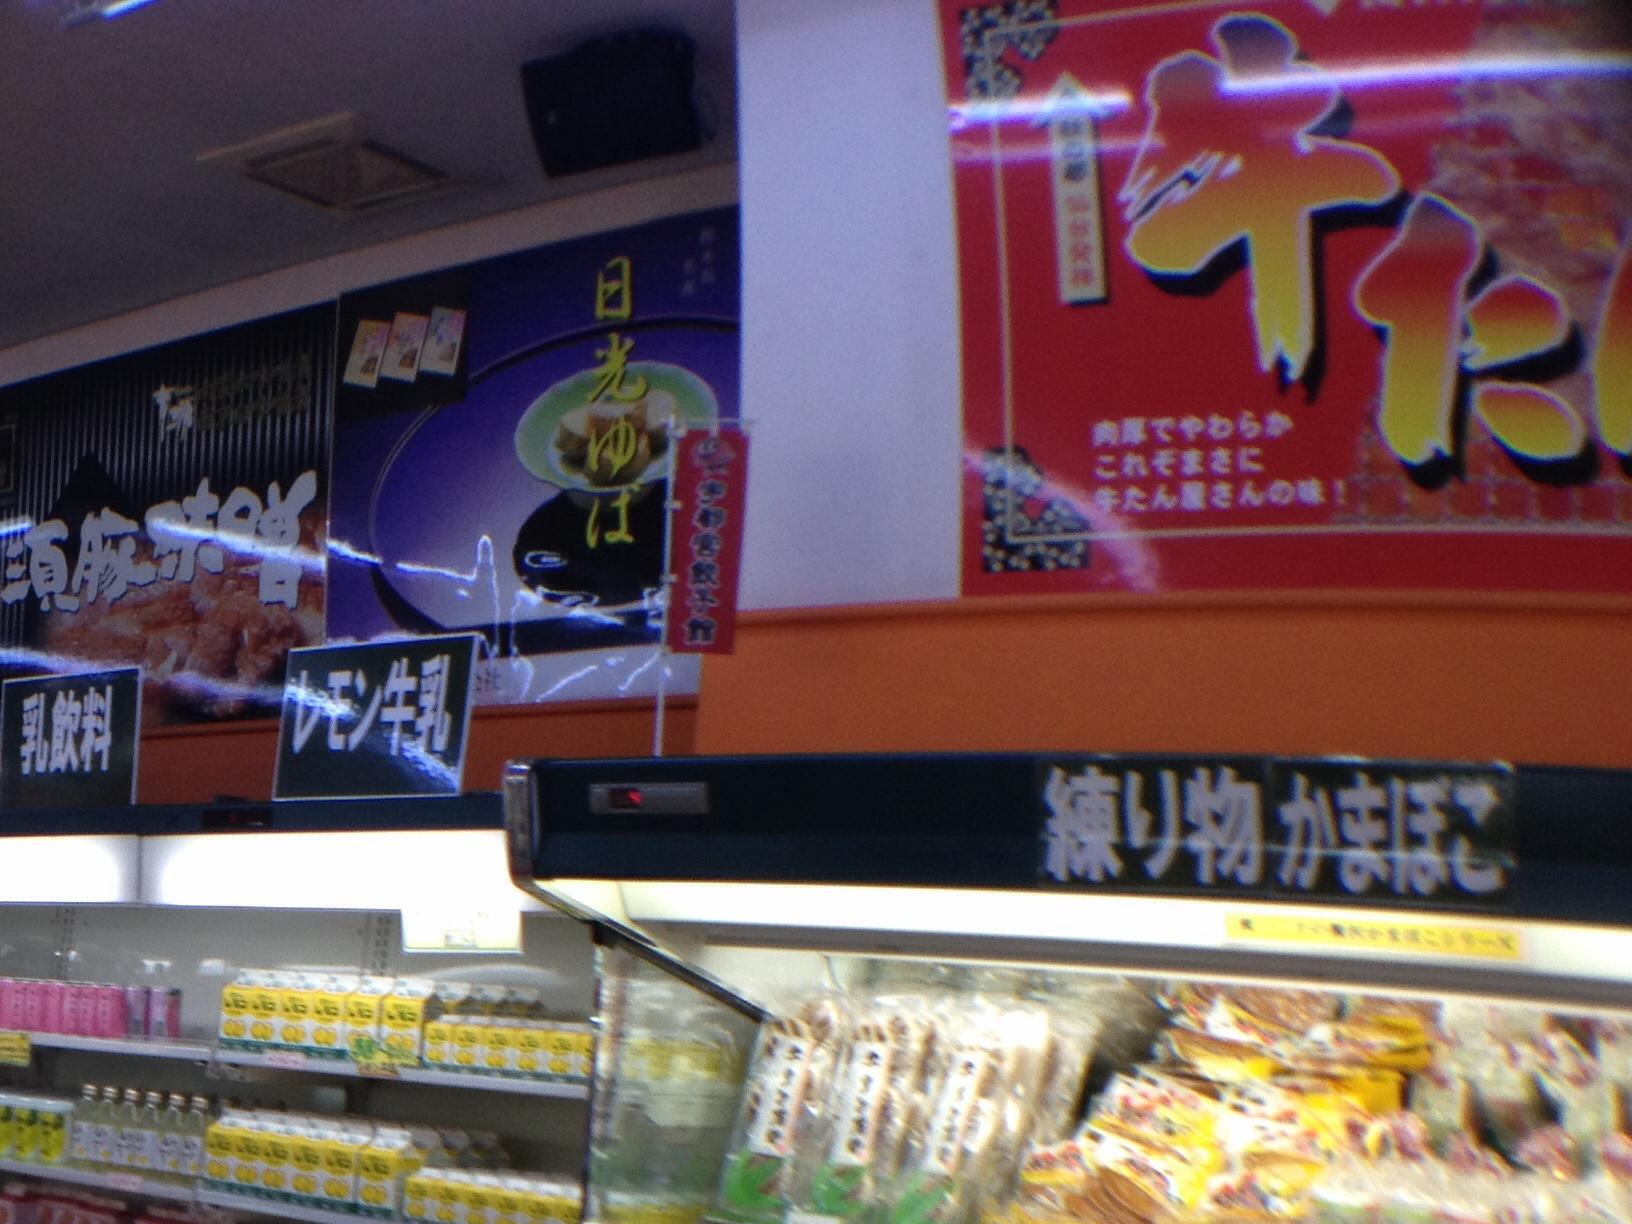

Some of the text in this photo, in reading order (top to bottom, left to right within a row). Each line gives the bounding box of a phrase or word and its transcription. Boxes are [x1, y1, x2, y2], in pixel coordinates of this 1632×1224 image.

[585, 257, 646, 549] 日光ゆば
[21, 685, 113, 776] 乳飲料
[289, 653, 454, 753] レモン牛乳
[1045, 765, 1504, 895] 練り物 かまぼこ
